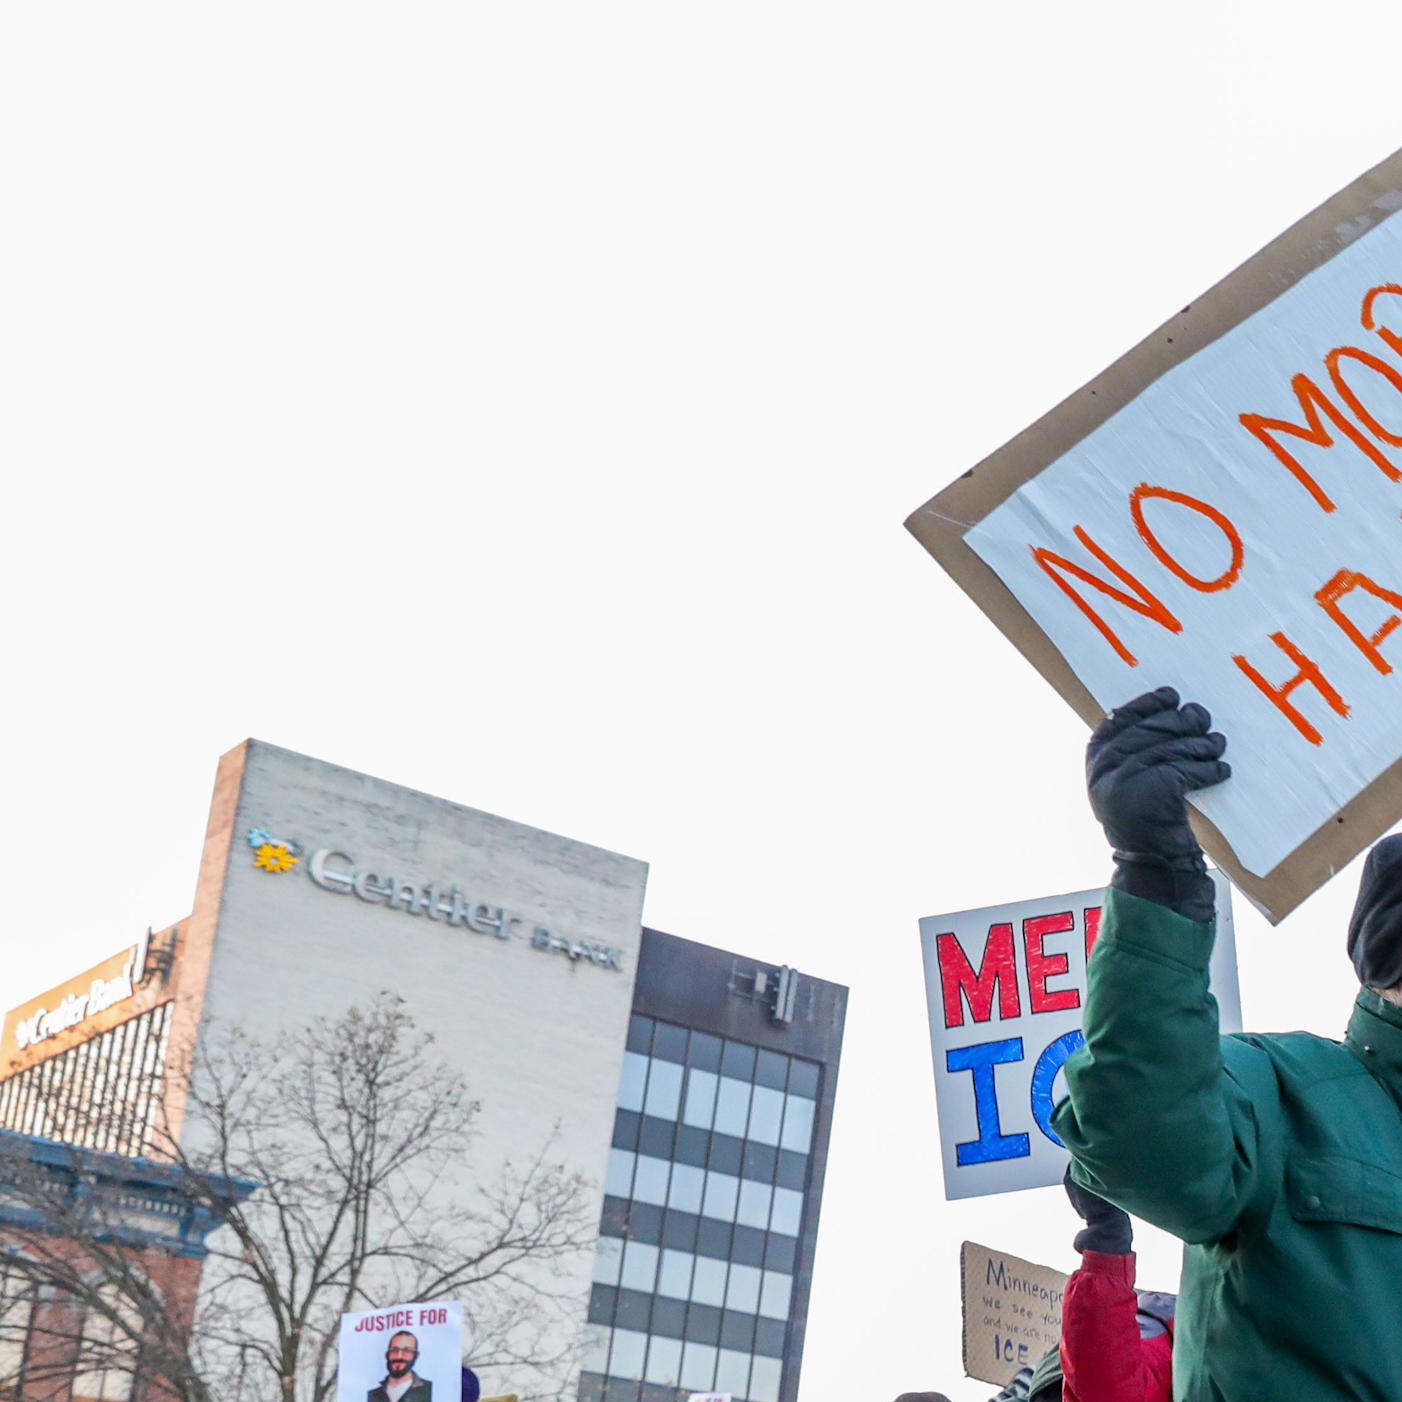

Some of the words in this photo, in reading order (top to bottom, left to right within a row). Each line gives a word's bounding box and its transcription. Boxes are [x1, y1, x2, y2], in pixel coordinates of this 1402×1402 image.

[1029, 482, 1245, 668] NO
[307, 849, 522, 941] Centier
[531, 925, 623, 973] BANK
[354, 1310, 413, 1332] JUSTICE
[419, 1308, 447, 1326] FOR
[995, 1333, 1028, 1365] ICE
